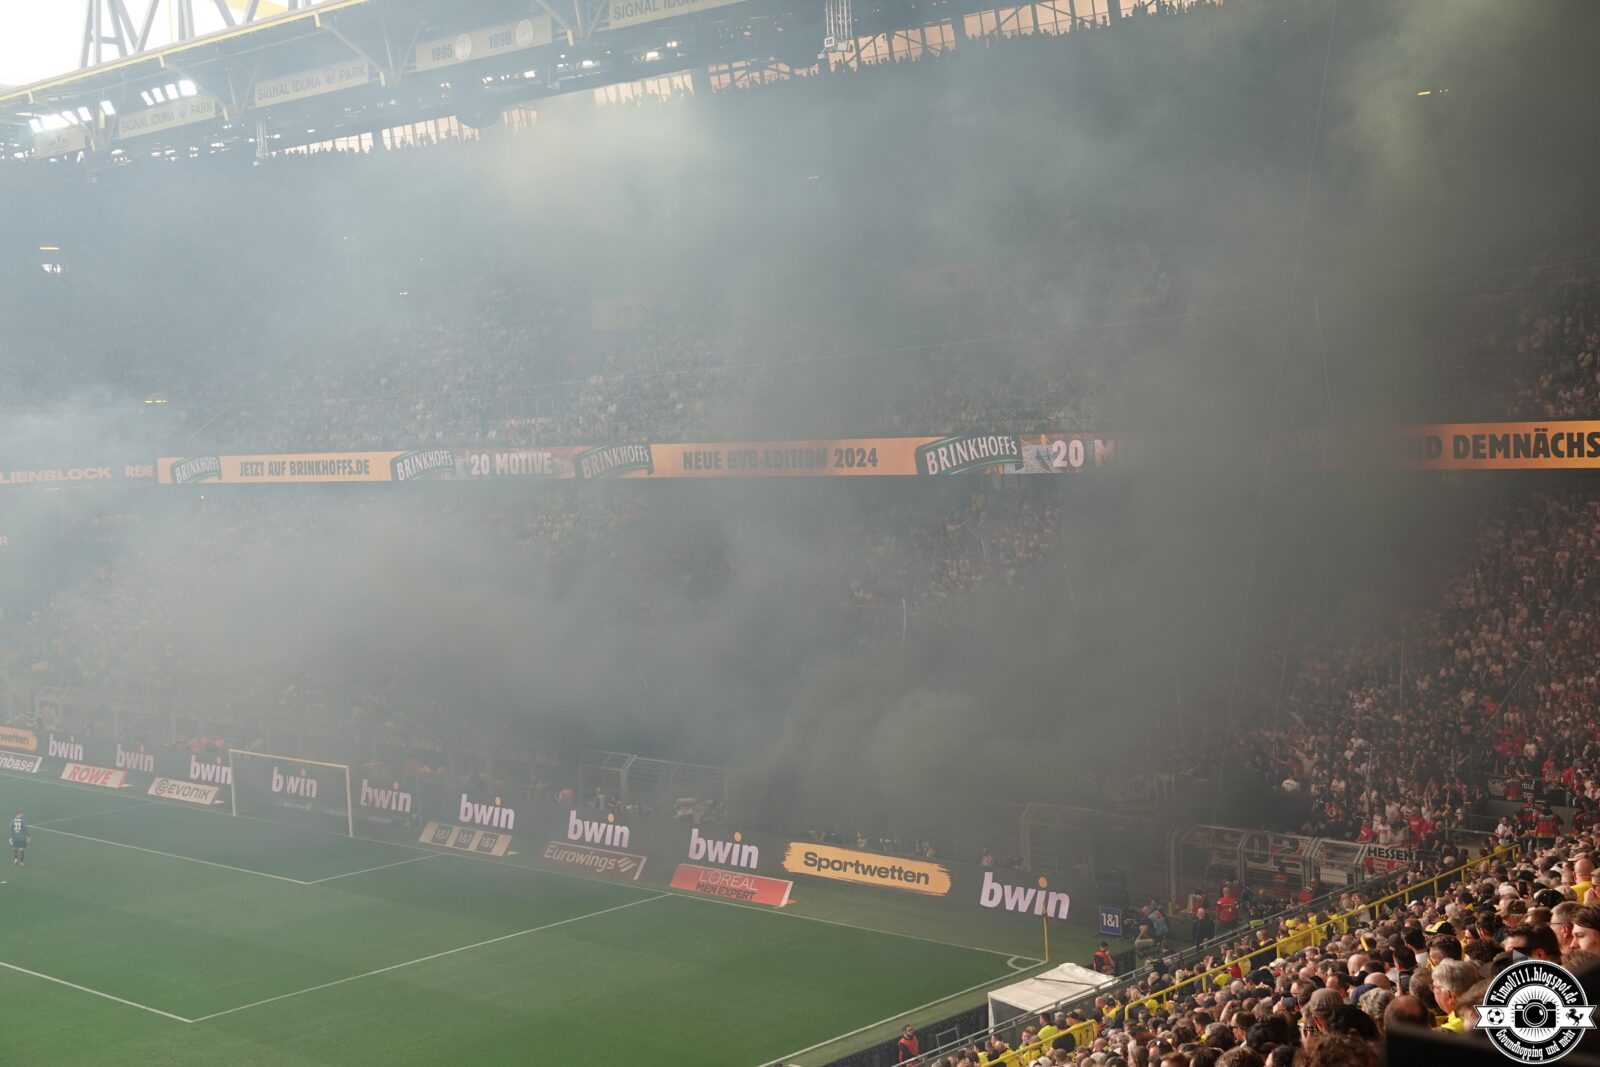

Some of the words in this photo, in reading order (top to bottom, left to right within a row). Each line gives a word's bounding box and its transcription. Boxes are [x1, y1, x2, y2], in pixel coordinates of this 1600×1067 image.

[613, 0, 660, 20] SIGNAL
[431, 44, 453, 61] 1995
[489, 30, 512, 48] 1996
[257, 83, 290, 100] SIGNAL
[292, 75, 320, 92] IDUNA
[340, 64, 366, 80] PARK
[122, 117, 149, 132] SIGNAL
[151, 110, 175, 124] IDUNA
[190, 102, 213, 114] PARK
[1052, 439, 1085, 468] 20
[1453, 427, 1600, 459] DEMNÄCHS
[240, 461, 265, 477] JETZT
[268, 461, 286, 477] AUF
[289, 459, 370, 476] BRINKHOFFS.DE
[471, 453, 490, 476] 20
[496, 452, 553, 475] MOTIVE
[683, 451, 722, 470] NEUE
[727, 448, 828, 469] BVB-EDITION
[834, 447, 879, 467] 2024
[48, 733, 83, 761] bwin
[116, 744, 154, 773] bwin
[69, 765, 114, 785] ROWE
[190, 754, 232, 785] bwin
[272, 766, 318, 798] bwin
[167, 783, 211, 800] EVONIK
[360, 778, 412, 813] bwin
[459, 793, 515, 830] bwin
[480, 837, 496, 849] 1&1
[567, 810, 630, 848] bwin
[543, 844, 616, 872] Eurowings
[688, 828, 759, 869] bwin
[803, 851, 930, 885] Sportwetten
[695, 883, 717, 895] MEN
[719, 886, 757, 901] EXPERT
[979, 871, 1071, 920] bwin
[1101, 912, 1119, 928] 1&1
